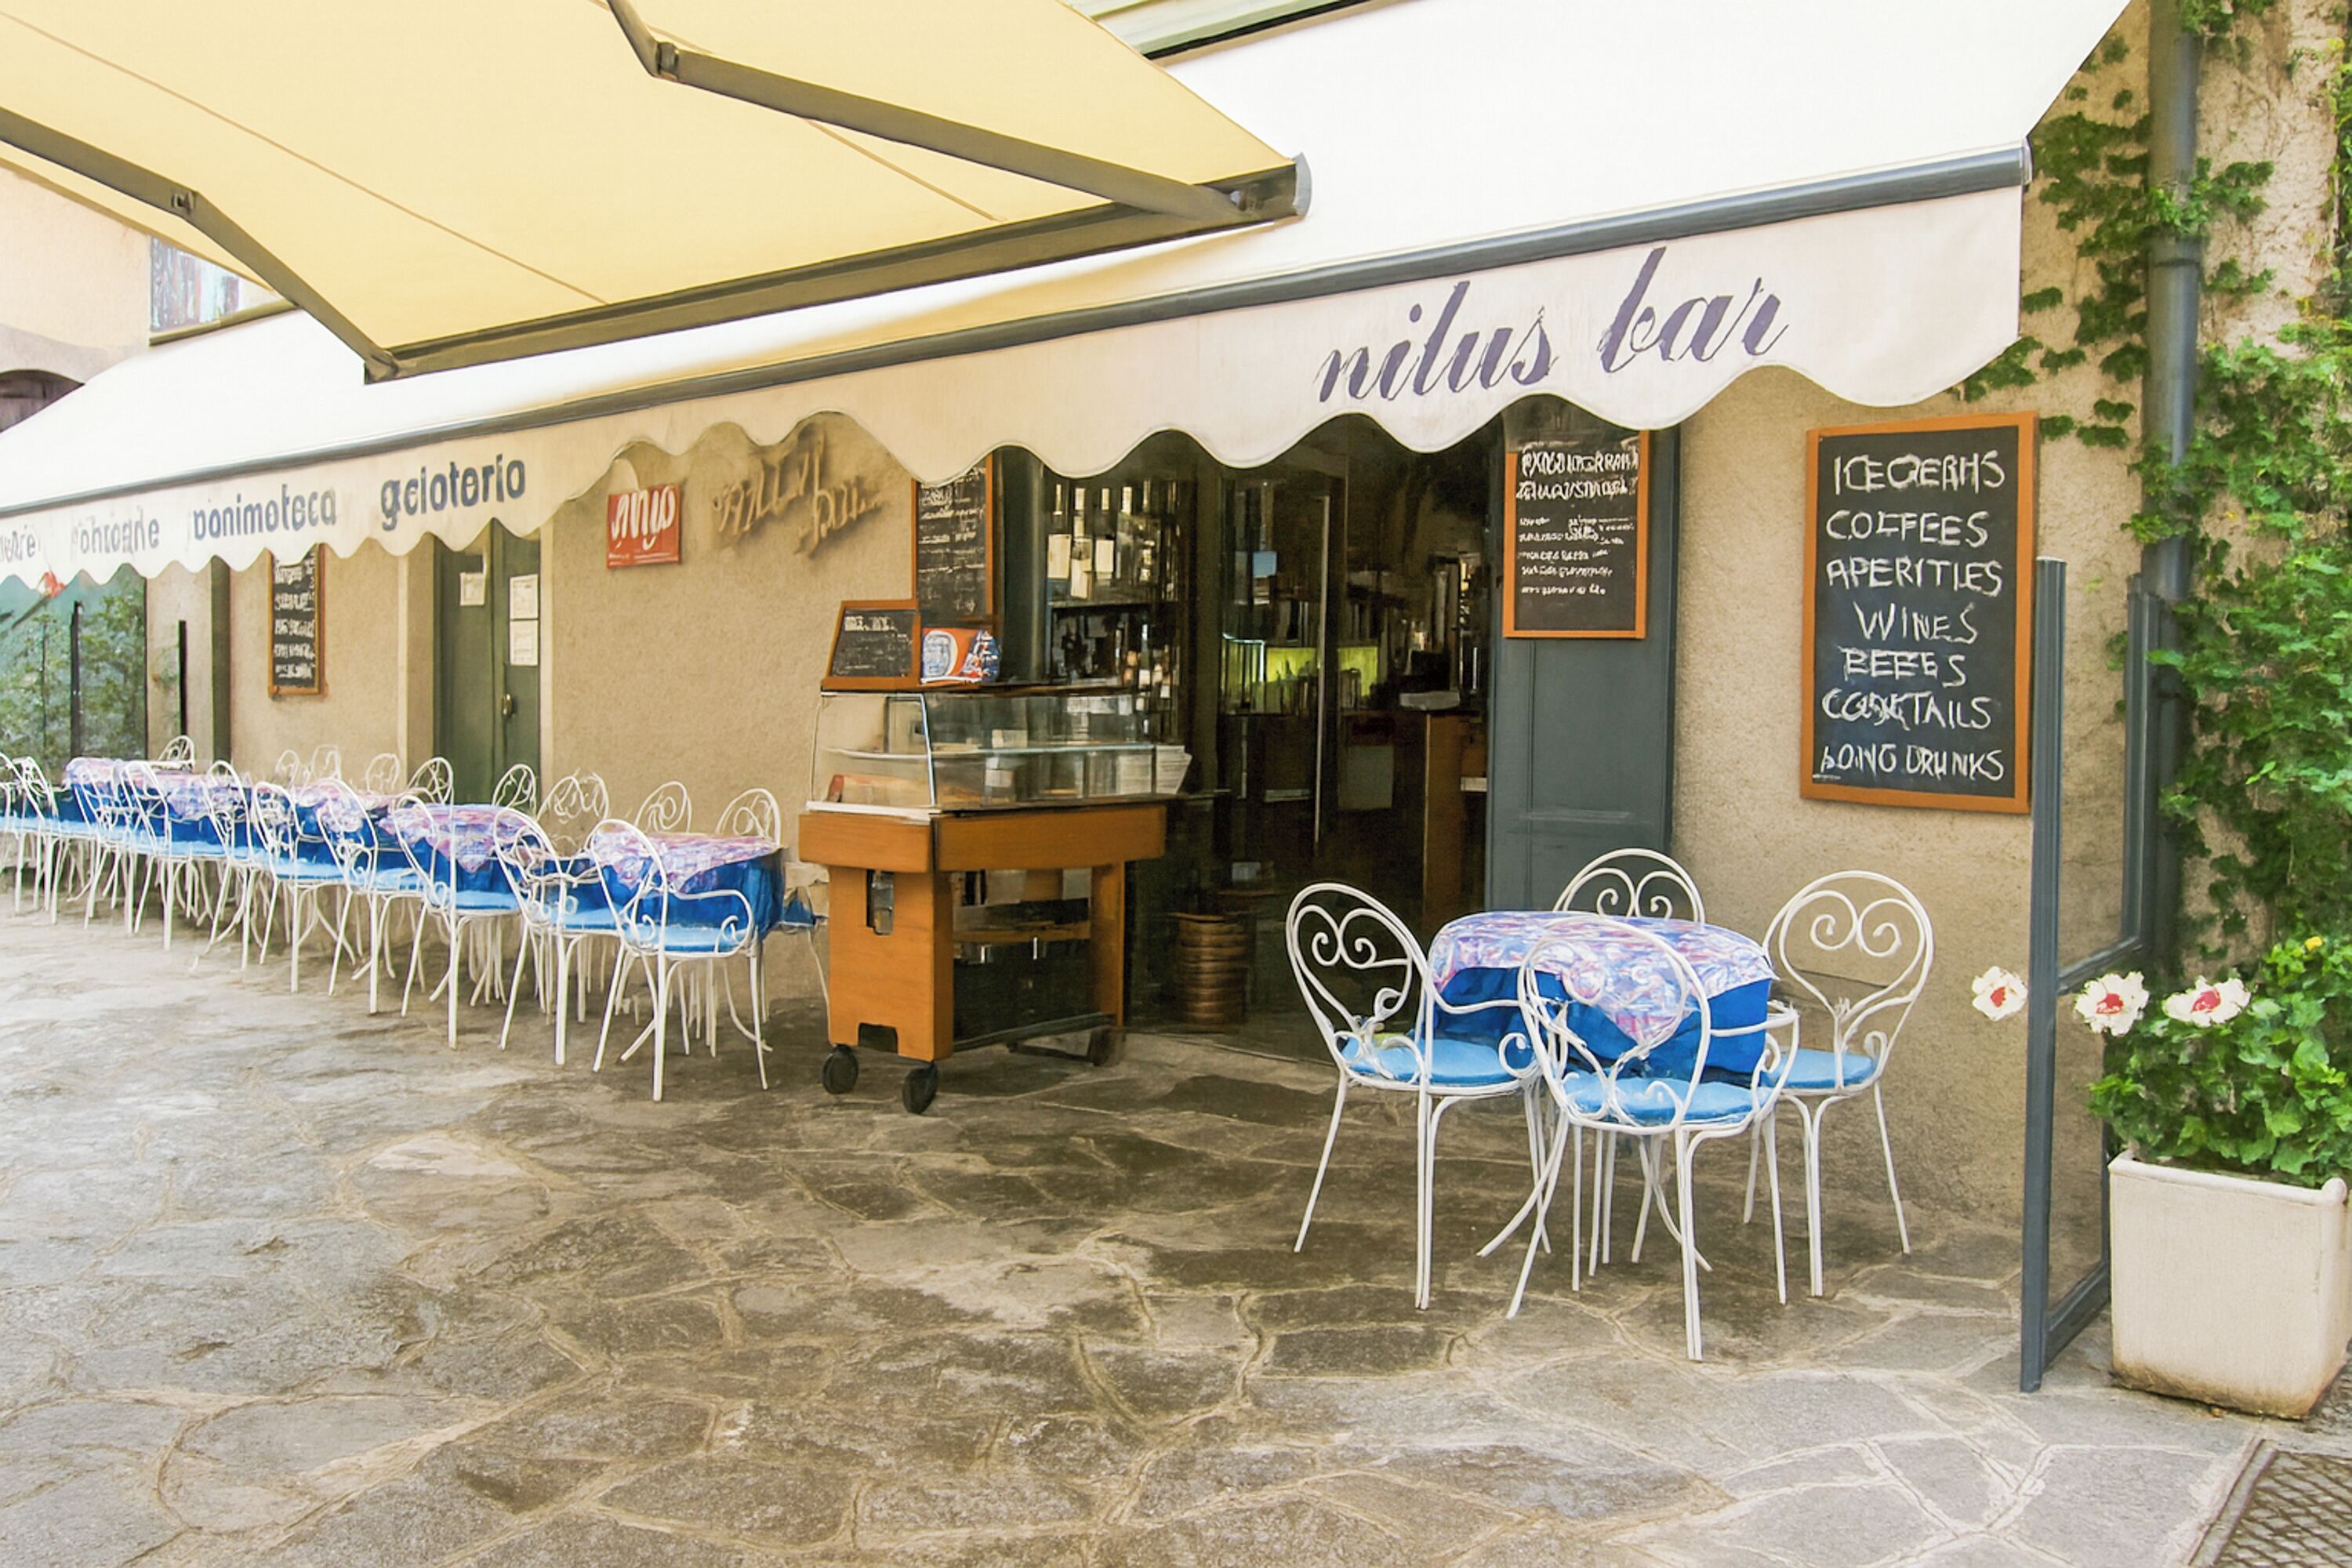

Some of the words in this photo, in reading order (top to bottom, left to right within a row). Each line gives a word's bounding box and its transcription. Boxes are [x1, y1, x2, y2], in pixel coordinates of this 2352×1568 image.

[1314, 280, 1559, 403] nilus
[1596, 245, 1789, 374] bar
[1853, 601, 1978, 644] WINES
